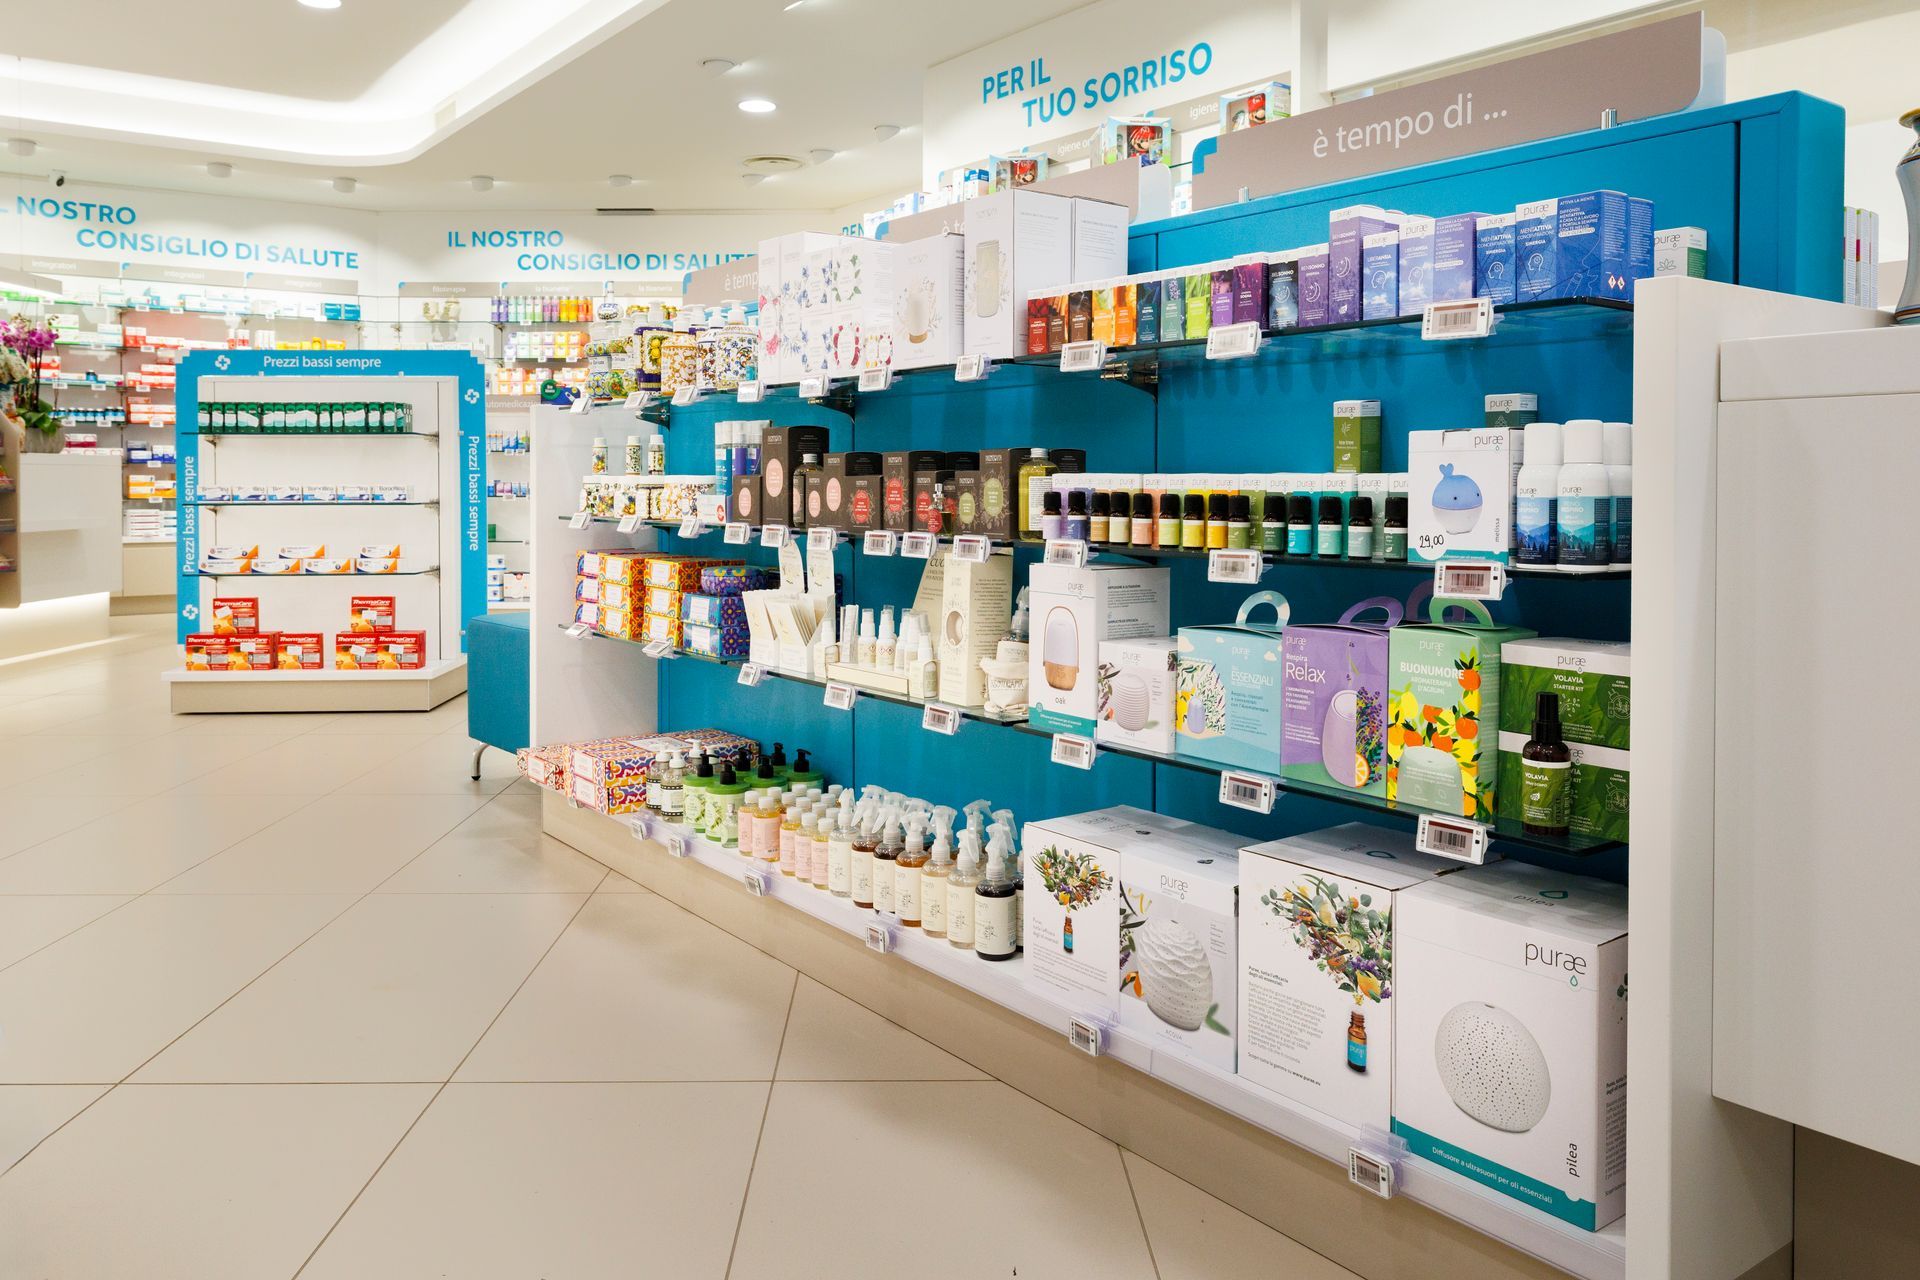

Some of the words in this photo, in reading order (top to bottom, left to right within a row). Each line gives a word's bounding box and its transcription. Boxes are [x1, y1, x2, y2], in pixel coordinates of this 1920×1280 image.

[982, 66, 1024, 104] PER
[1031, 57, 1051, 87] IL
[1022, 87, 1075, 128] TUO
[1083, 41, 1213, 109] SORRISO
[1190, 102, 1219, 119] igiene
[1313, 129, 1329, 158] è
[1336, 109, 1434, 153] tempo
[1443, 93, 1473, 126] di
[1057, 141, 1081, 157] igiene
[16, 196, 136, 225] NOSTRO
[76, 229, 228, 257] CONSIGLIO
[235, 242, 259, 261] DI
[267, 245, 359, 269] SALUTE
[448, 231, 466, 247] IL
[472, 230, 564, 247] NOSTRO
[517, 253, 640, 271] CONSIGLIO
[646, 253, 667, 270] DI
[732, 271, 758, 291] temp
[263, 356, 299, 368] Prezzi
[302, 355, 333, 368] bassi
[335, 357, 382, 371] sempre
[468, 436, 480, 471] Prezzi
[1475, 434, 1504, 448] puræ
[184, 455, 197, 501] sempre
[469, 474, 481, 508] bassi
[468, 511, 481, 551] sempre
[182, 538, 195, 574] Prezzi
[1285, 662, 1326, 684] Relax
[1400, 661, 1465, 680] BUONUMORE
[1557, 655, 1586, 667] puræ
[1553, 674, 1584, 684] VOLAVIA
[1524, 771, 1549, 781] VOLAVIA
[1161, 874, 1188, 892] puræ
[1525, 941, 1587, 975] puræ
[1566, 1143, 1580, 1178] pilea
[1432, 1146, 1460, 1164] Diffusore
[1465, 1161, 1497, 1181] ultrasuoni
[1498, 1176, 1509, 1186] per
[1510, 1180, 1519, 1190] oli
[1520, 1184, 1553, 1204] essenziali
